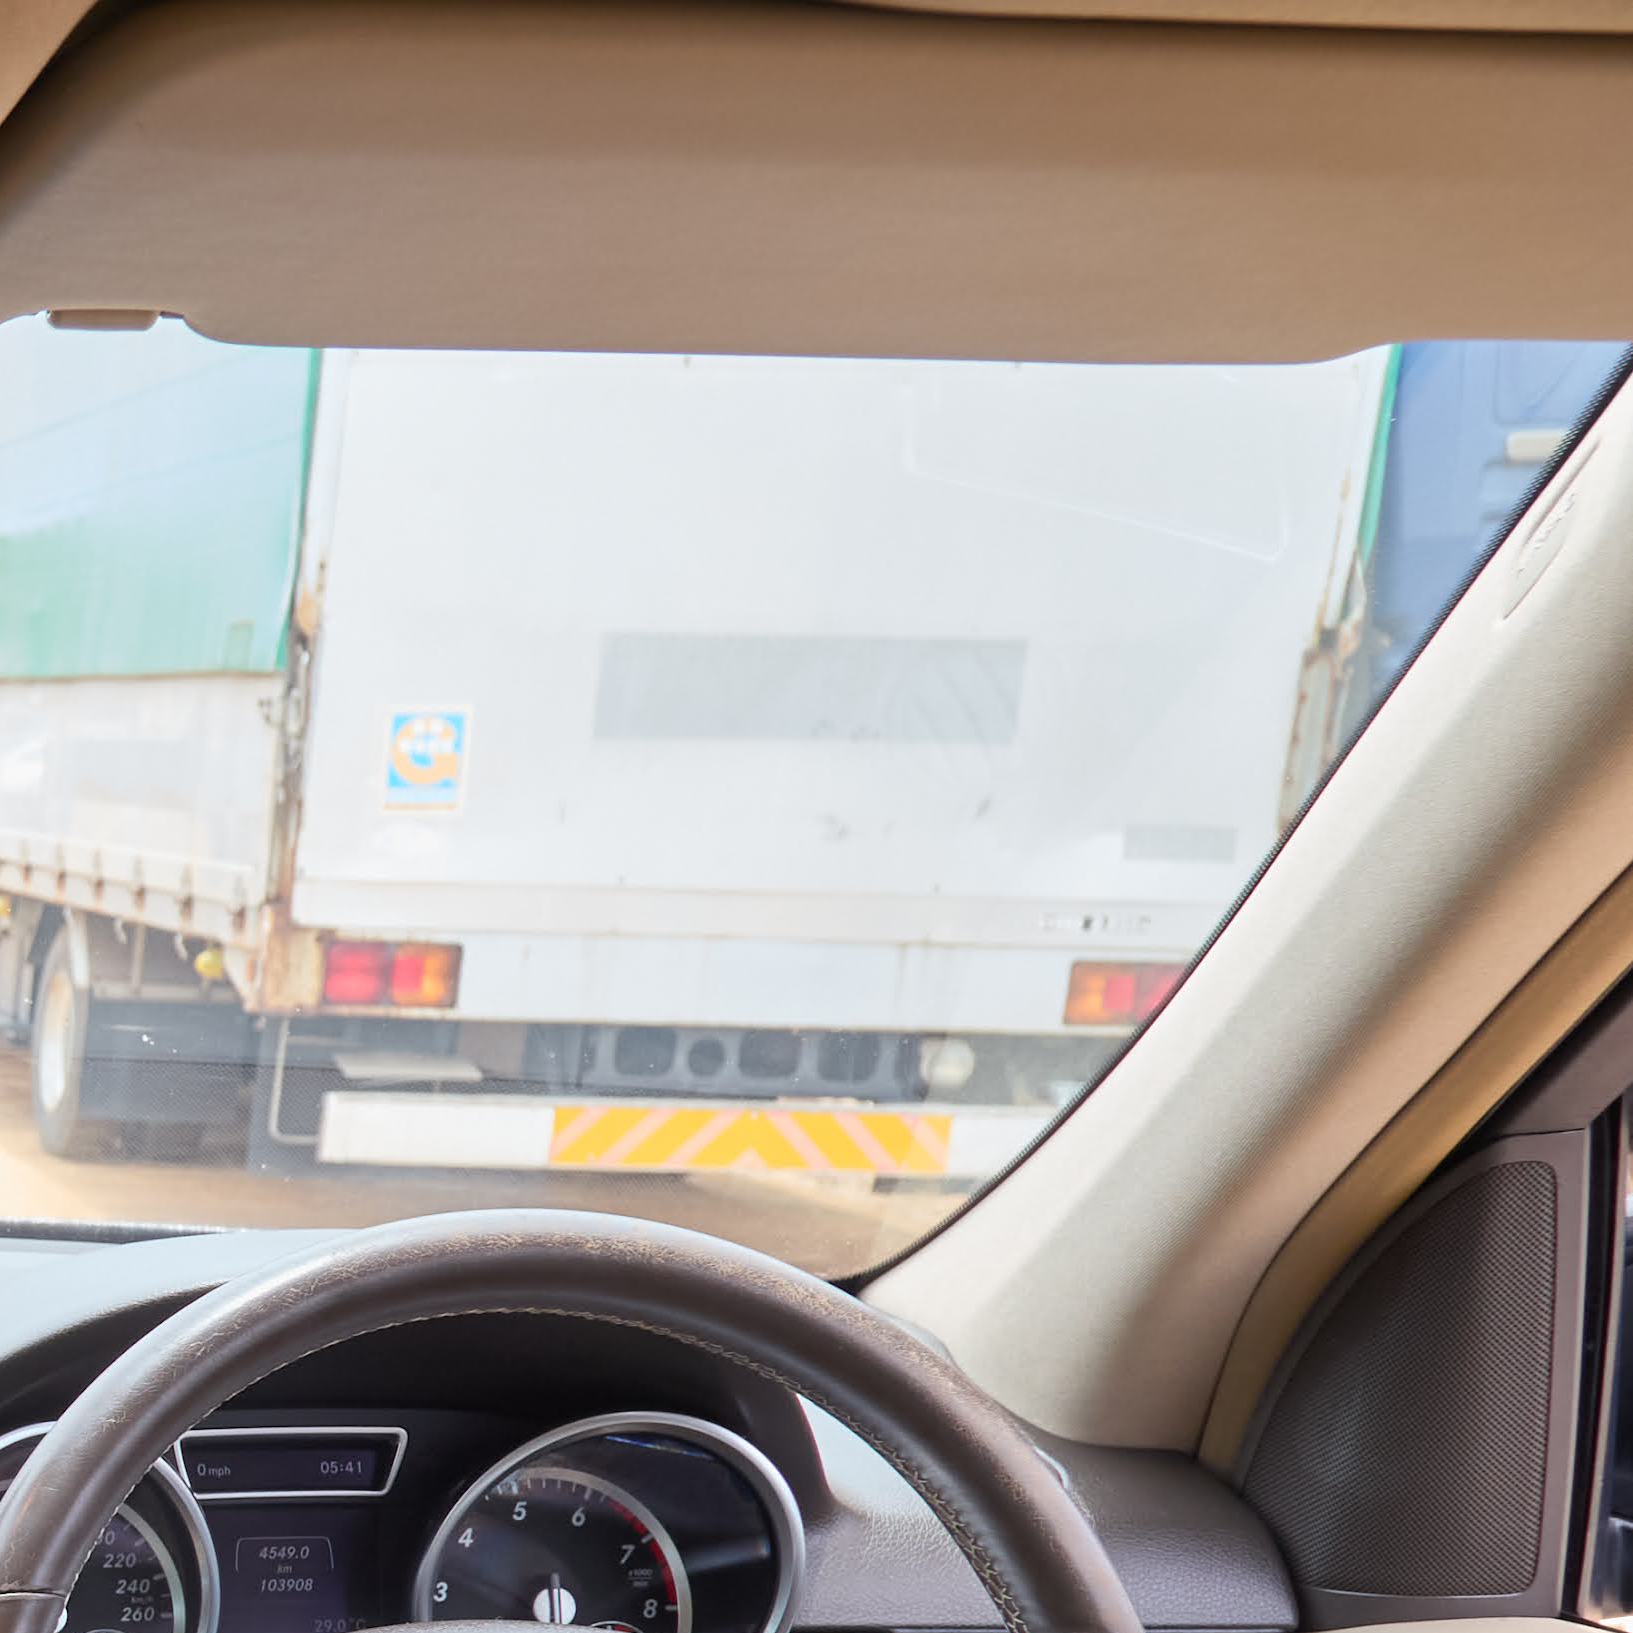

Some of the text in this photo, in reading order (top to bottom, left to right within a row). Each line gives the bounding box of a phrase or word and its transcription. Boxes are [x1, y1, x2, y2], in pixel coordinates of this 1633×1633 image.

[196, 1463, 231, 1478] 0 mph
[320, 1460, 363, 1474] 05:41
[511, 1501, 527, 1522] 5
[571, 1506, 586, 1528] 6
[457, 1527, 475, 1549] 4
[102, 1552, 137, 1569] 220
[258, 1546, 310, 1560] 4549.0
[619, 1544, 635, 1566] 7
[276, 1564, 293, 1574] km
[114, 1579, 151, 1594] 240
[260, 1578, 314, 1592] 103908
[433, 1581, 449, 1603] 3
[119, 1606, 155, 1623] 260
[642, 1599, 658, 1619] 8
